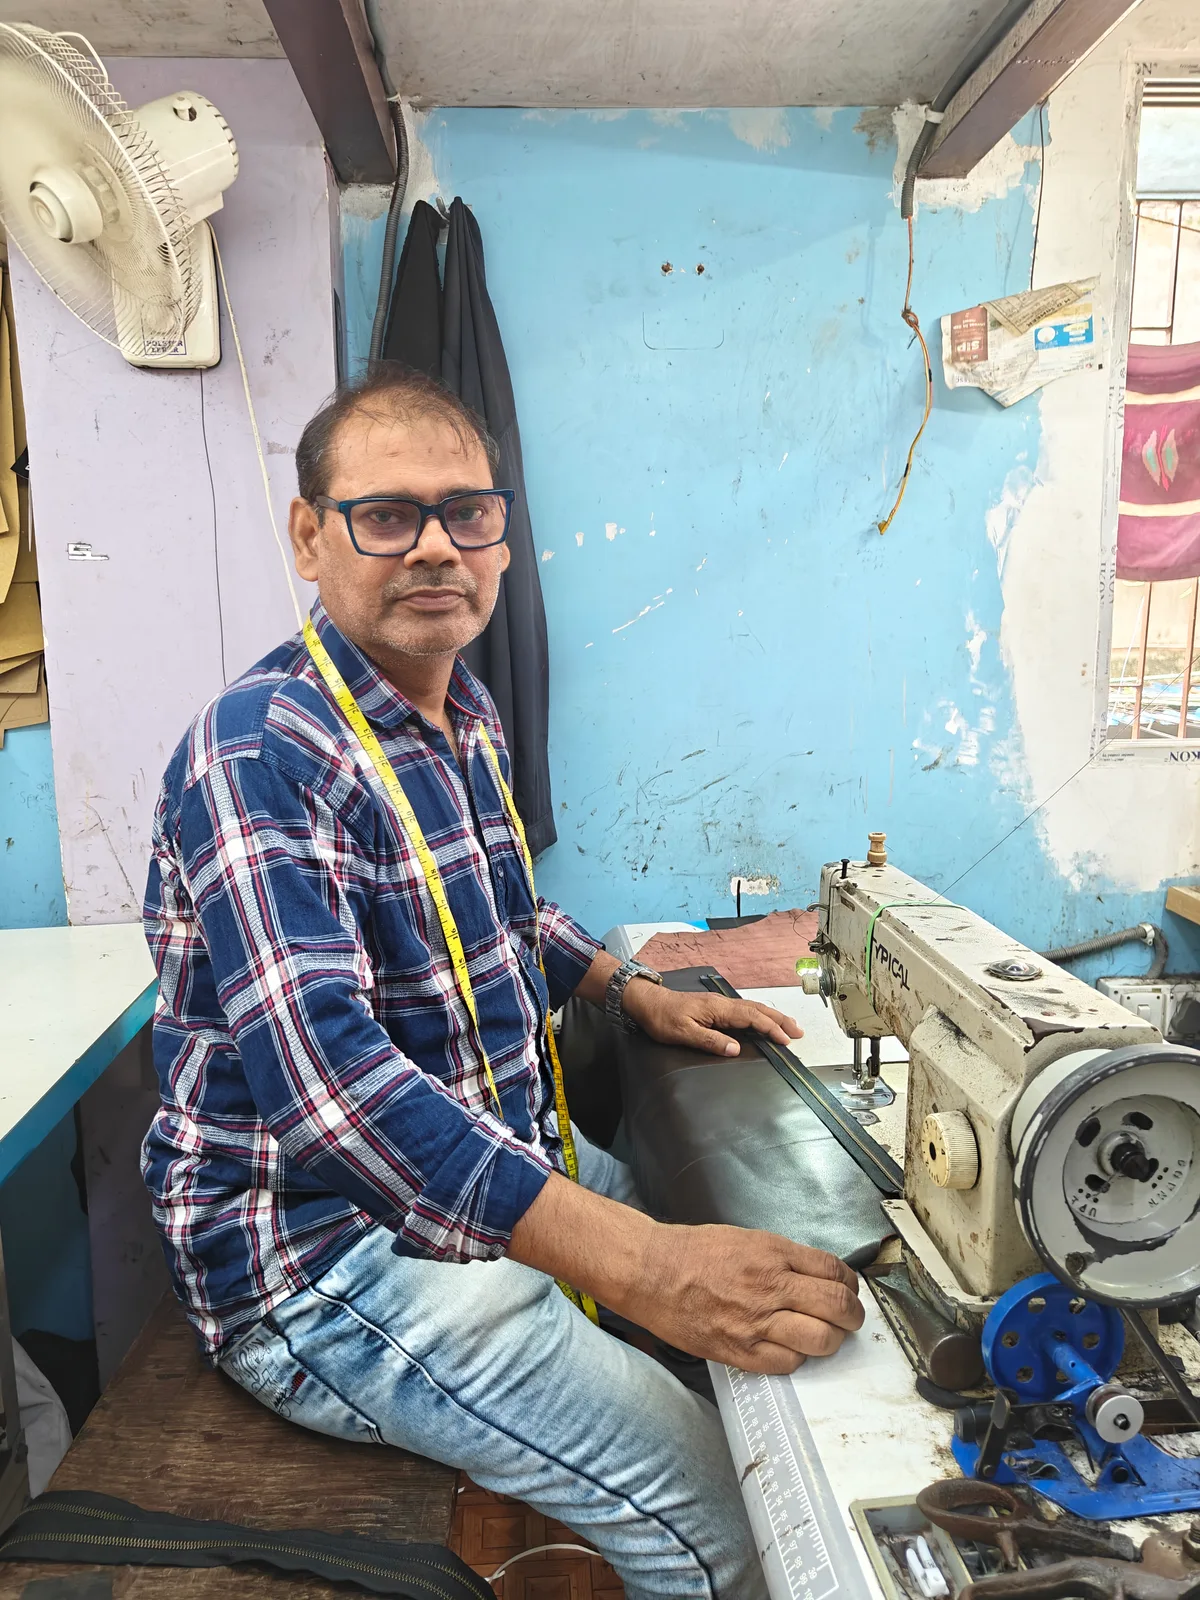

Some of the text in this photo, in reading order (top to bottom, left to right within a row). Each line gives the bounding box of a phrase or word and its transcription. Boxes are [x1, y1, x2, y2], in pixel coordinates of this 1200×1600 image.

[956, 340, 980, 353] SIP
[789, 1539, 798, 1551] 97
[794, 1555, 803, 1569] 98
[799, 1572, 808, 1585] 99
[808, 1567, 818, 1579] 39
